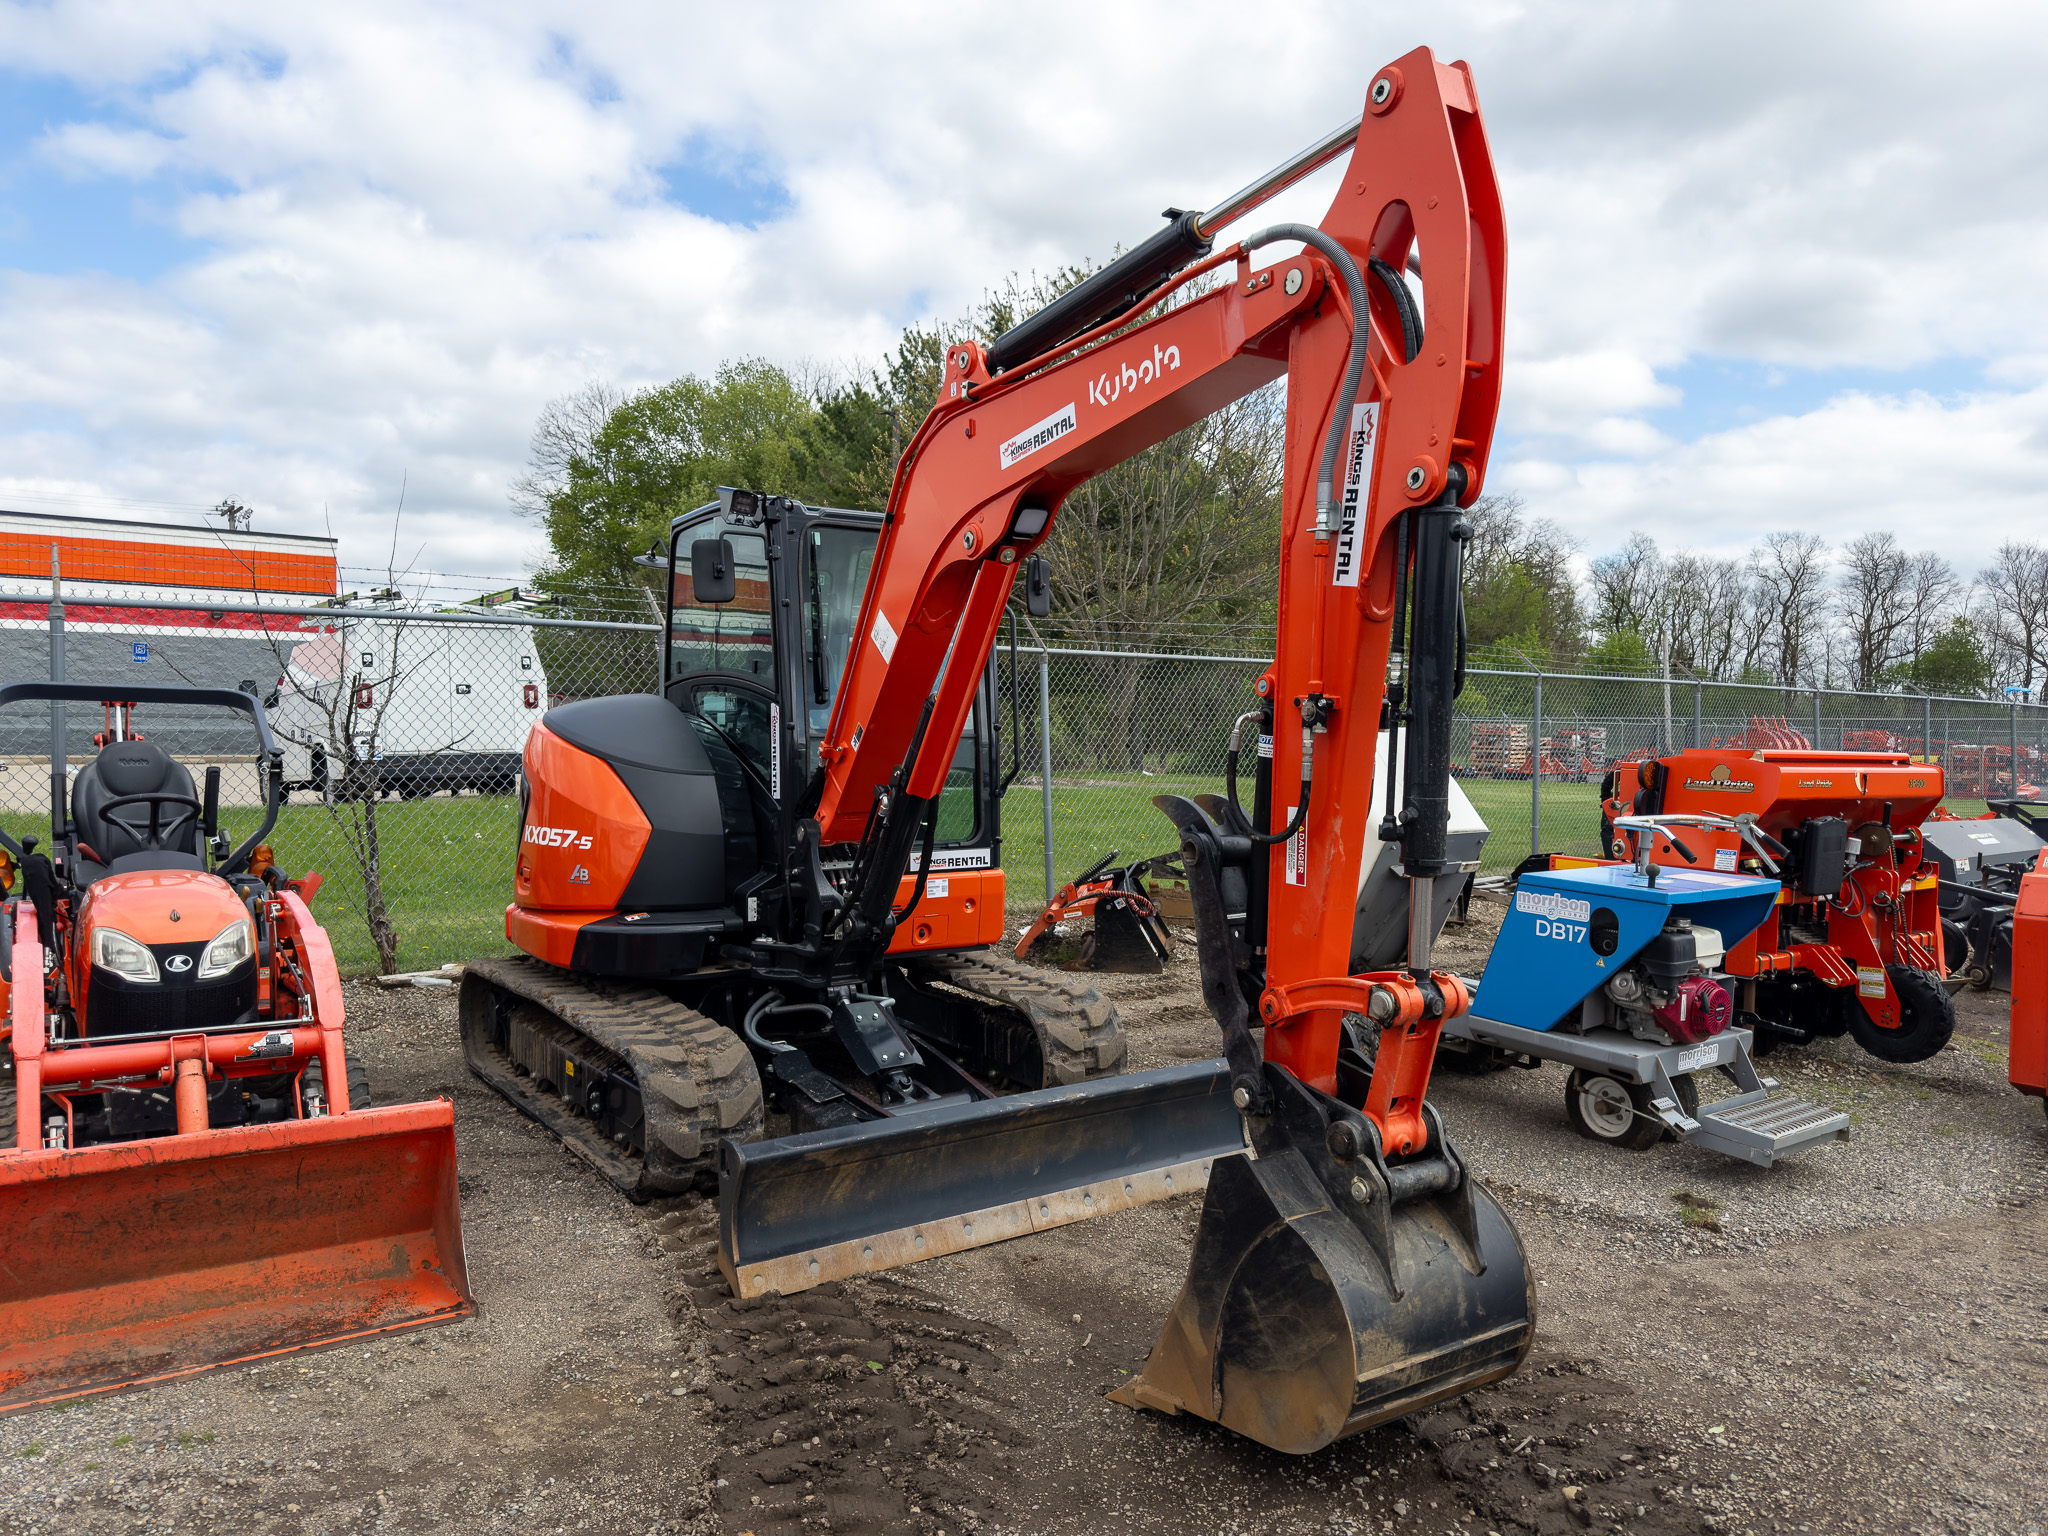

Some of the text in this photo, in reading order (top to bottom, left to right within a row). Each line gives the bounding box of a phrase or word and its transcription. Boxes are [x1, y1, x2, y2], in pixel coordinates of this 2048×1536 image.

[1088, 343, 1181, 407] Kubota
[1010, 415, 1075, 457] KINGS RENTAL
[1011, 446, 1033, 462] EQUIPMENT
[1347, 430, 1358, 486] EQUIPMENT
[1336, 430, 1366, 582] KINGS RENTAL
[1686, 777, 1755, 790] Land Pride
[1798, 779, 1832, 788] Land Pride
[524, 824, 594, 850] KX057-5
[947, 856, 989, 867] RENTAL
[1297, 833, 1305, 874] DANGER
[1517, 892, 1589, 914] morrison
[1558, 910, 1588, 919] GLOBAL
[1535, 919, 1587, 944] DB17
[1680, 1044, 1718, 1063] morrison
